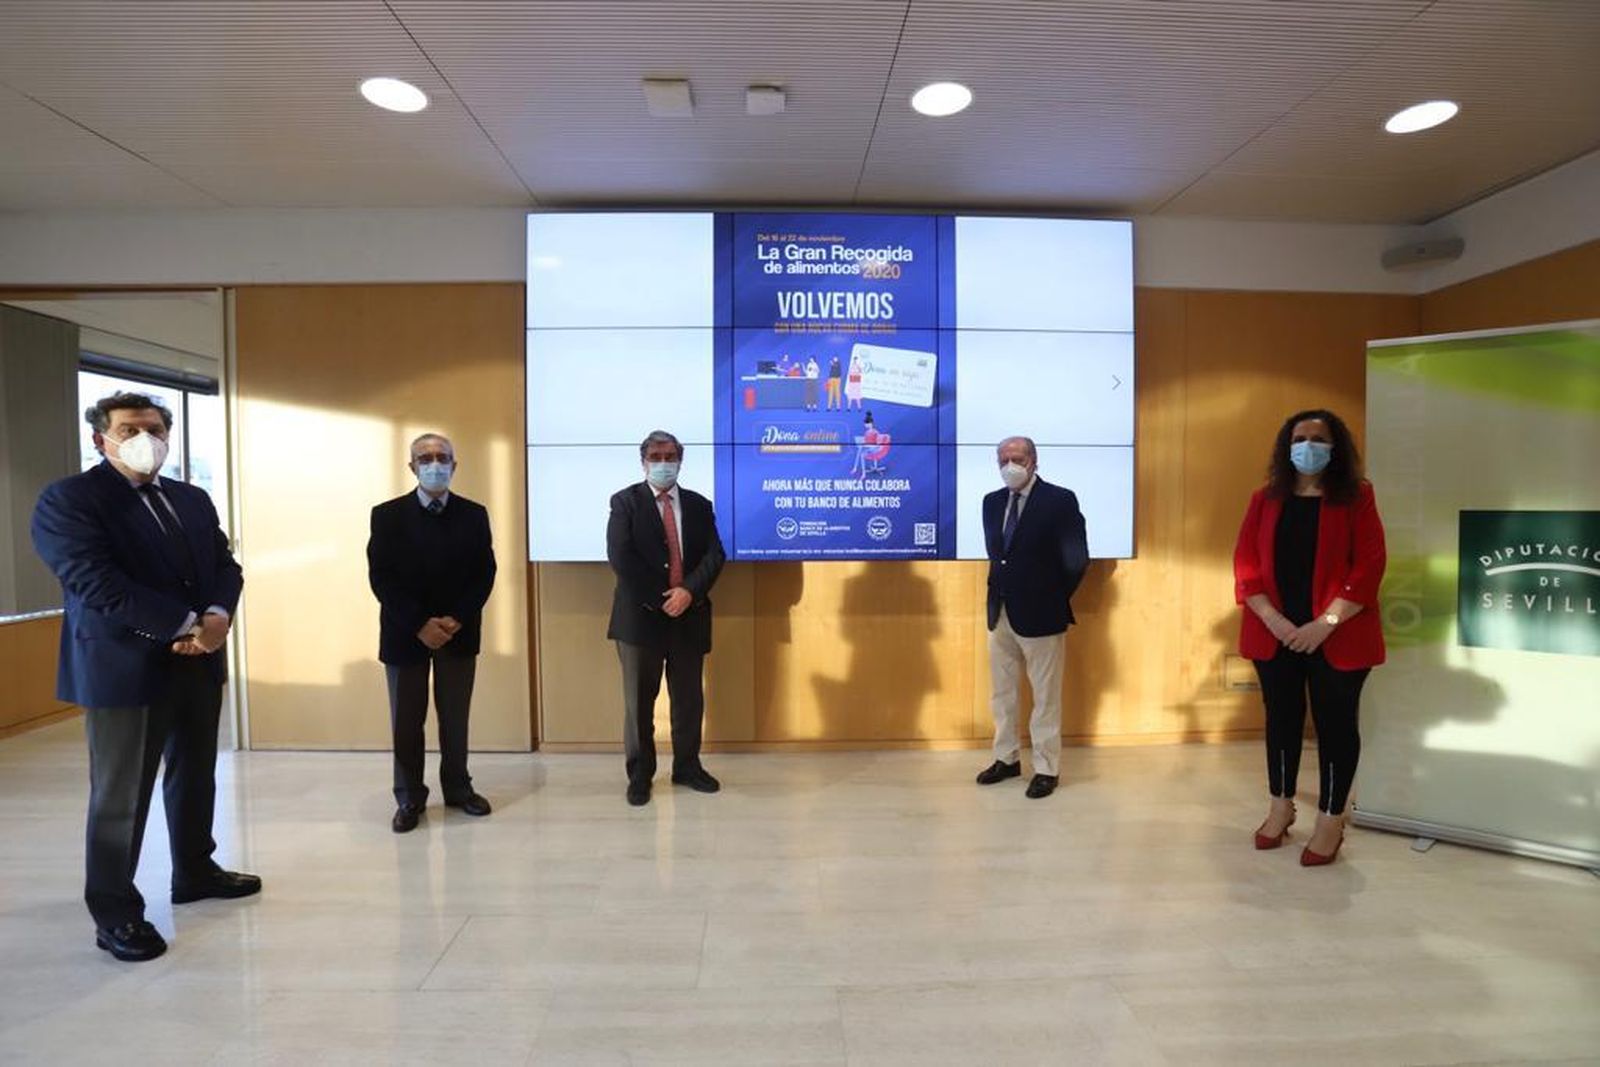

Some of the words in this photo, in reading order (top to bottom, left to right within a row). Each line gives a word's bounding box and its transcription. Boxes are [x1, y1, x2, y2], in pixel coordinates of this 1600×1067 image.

[809, 235, 845, 243] noviembre
[758, 243, 780, 260] La
[784, 244, 827, 260] Gran
[831, 245, 913, 264] Recogida
[764, 260, 783, 274] de
[787, 261, 860, 275] alimentos
[863, 264, 901, 279] 2020
[777, 291, 894, 319] VOLVEMOS
[762, 480, 792, 491] AHORA
[794, 477, 813, 491] MÁS
[815, 479, 833, 491] QUE
[834, 479, 864, 491] NUNCA
[865, 479, 910, 491] COLABORA
[774, 497, 793, 508] CON
[795, 497, 806, 508] TU
[808, 496, 837, 508] BANCO
[839, 496, 850, 508] DE
[852, 496, 901, 508] ALIMENTOS
[1540, 576, 1561, 587] DE
